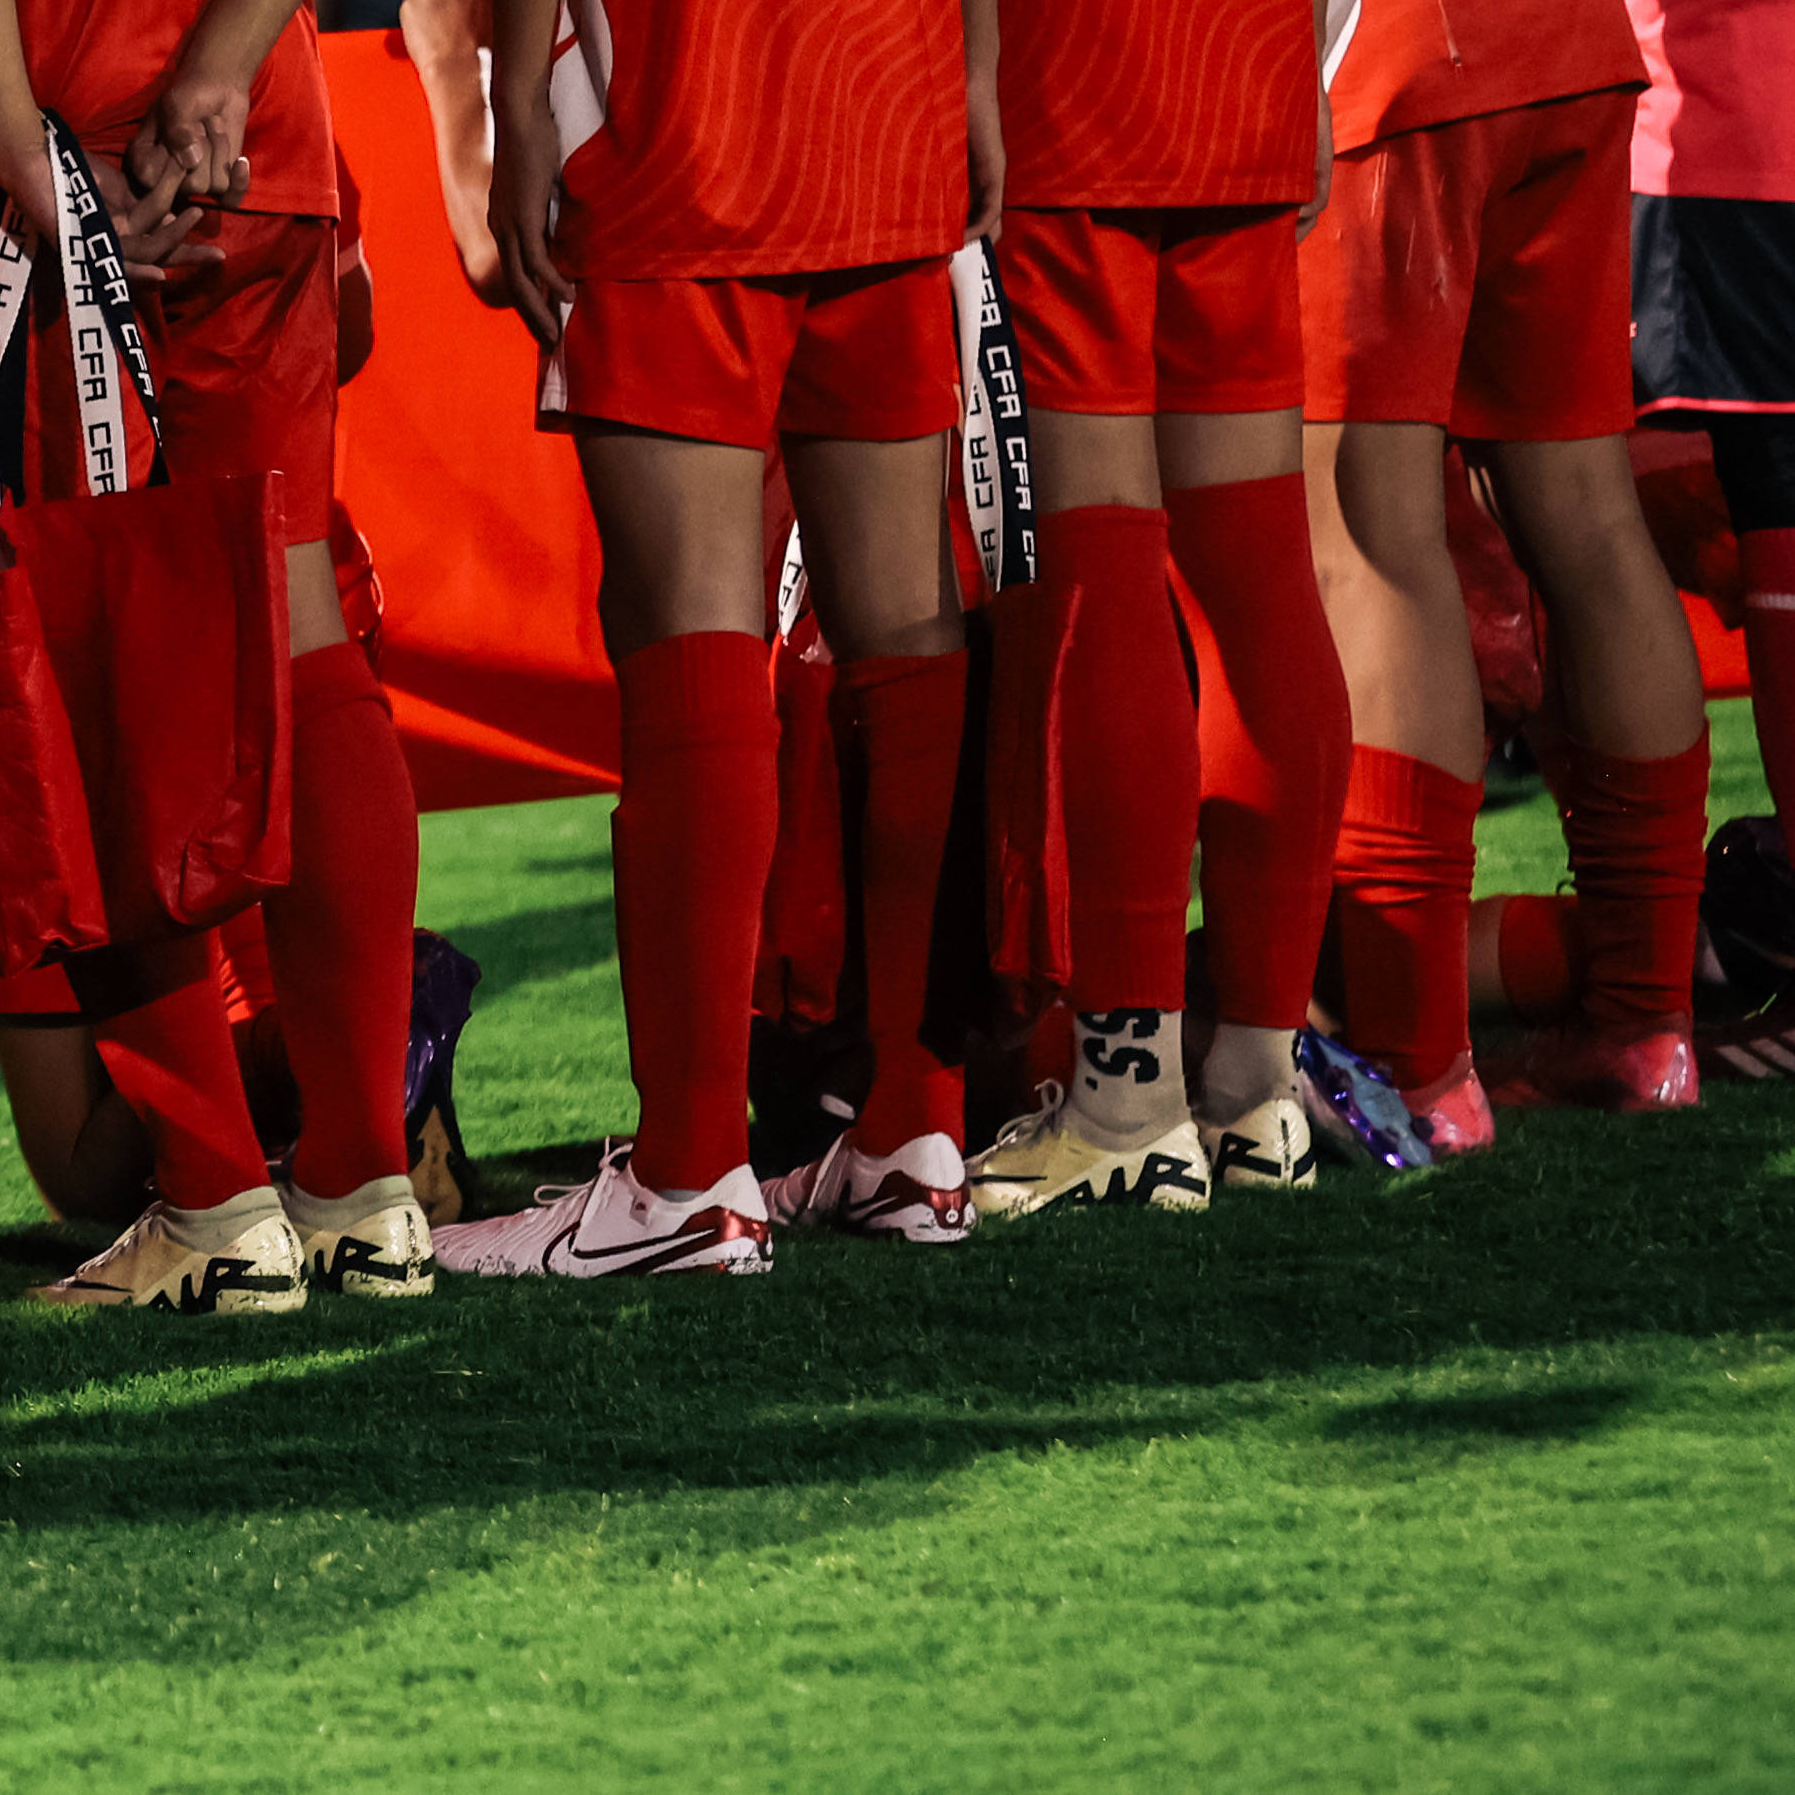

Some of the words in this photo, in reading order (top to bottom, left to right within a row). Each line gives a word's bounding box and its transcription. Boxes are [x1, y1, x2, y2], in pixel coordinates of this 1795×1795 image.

[86, 231, 131, 306] CFA
[120, 322, 155, 397] CFA
[78, 326, 109, 403] CFA
[87, 421, 117, 496] CFA
[985, 344, 1023, 419] CFA
[1004, 435, 1033, 512] CFA
[969, 435, 996, 511] CFA
